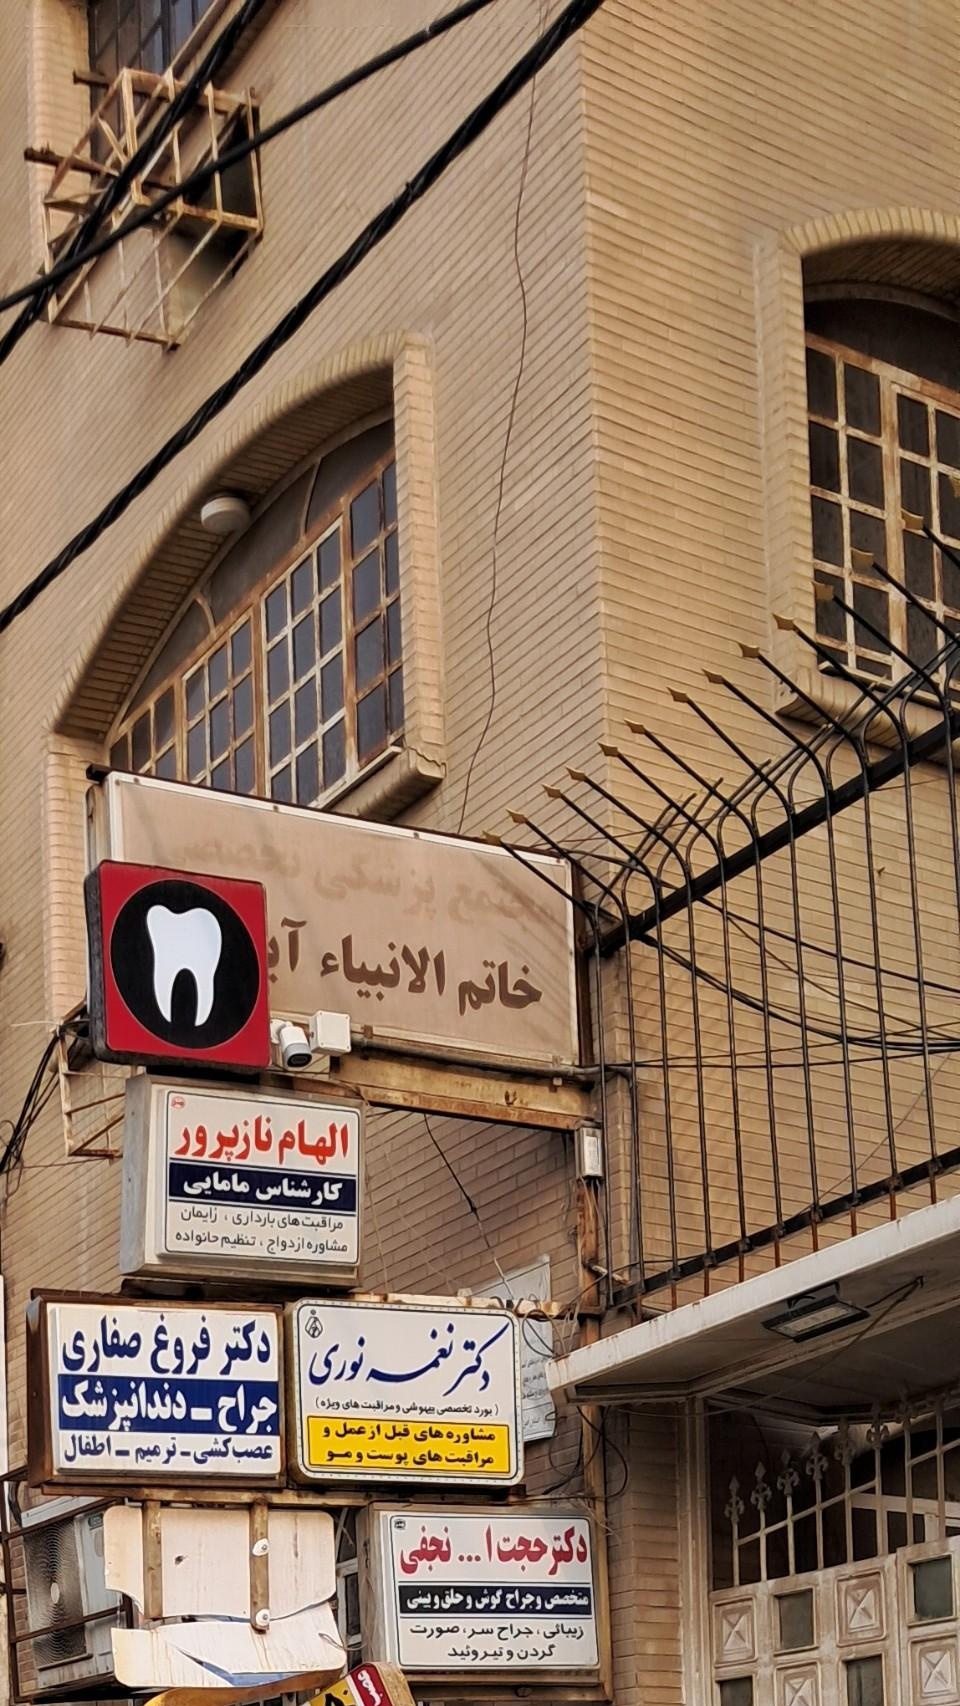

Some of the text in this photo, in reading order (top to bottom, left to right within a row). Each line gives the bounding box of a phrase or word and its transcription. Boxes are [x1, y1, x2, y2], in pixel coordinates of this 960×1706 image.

[320, 933, 446, 1002] الانبیاء
[458, 959, 543, 1017] خاتم
[174, 1114, 350, 1166] الهام نازپرور
[183, 1169, 343, 1206] کارشناس مامایی
[180, 1206, 218, 1223] زایمان
[175, 1229, 220, 1248] خانواده
[221, 1232, 257, 1249] تنظیم
[306, 1238, 348, 1256] مشاوره
[62, 1313, 271, 1376] دکتر فروغ صفاری
[366, 1322, 454, 1383] نغمه
[308, 1336, 366, 1386] نوری
[442, 1321, 510, 1397] دکتر
[62, 1379, 278, 1434] جراح دندانپزشک
[341, 1398, 360, 1411] های
[361, 1399, 395, 1415] مراقبت
[402, 1399, 436, 1416] بیهوشی
[436, 1403, 473, 1417] تخصصی
[323, 1420, 496, 1445] مشاوره های قبل از عمل و
[64, 1432, 113, 1463] اطفال
[135, 1436, 177, 1465] ترمیم
[326, 1448, 494, 1468] مراقبت های پوست و مو
[400, 1525, 452, 1575] نجفی
[496, 1535, 549, 1573] حجت
[548, 1525, 588, 1576] دکتر
[406, 1589, 433, 1610] بینی
[441, 1587, 465, 1610] حلق
[475, 1587, 504, 1610] گوش
[505, 1590, 536, 1610] جراح
[544, 1588, 589, 1610] متخصص
[409, 1622, 460, 1639] صورت
[497, 1622, 534, 1641] جراح
[447, 1643, 504, 1661] تیروئید
[517, 1642, 557, 1660] گردن
